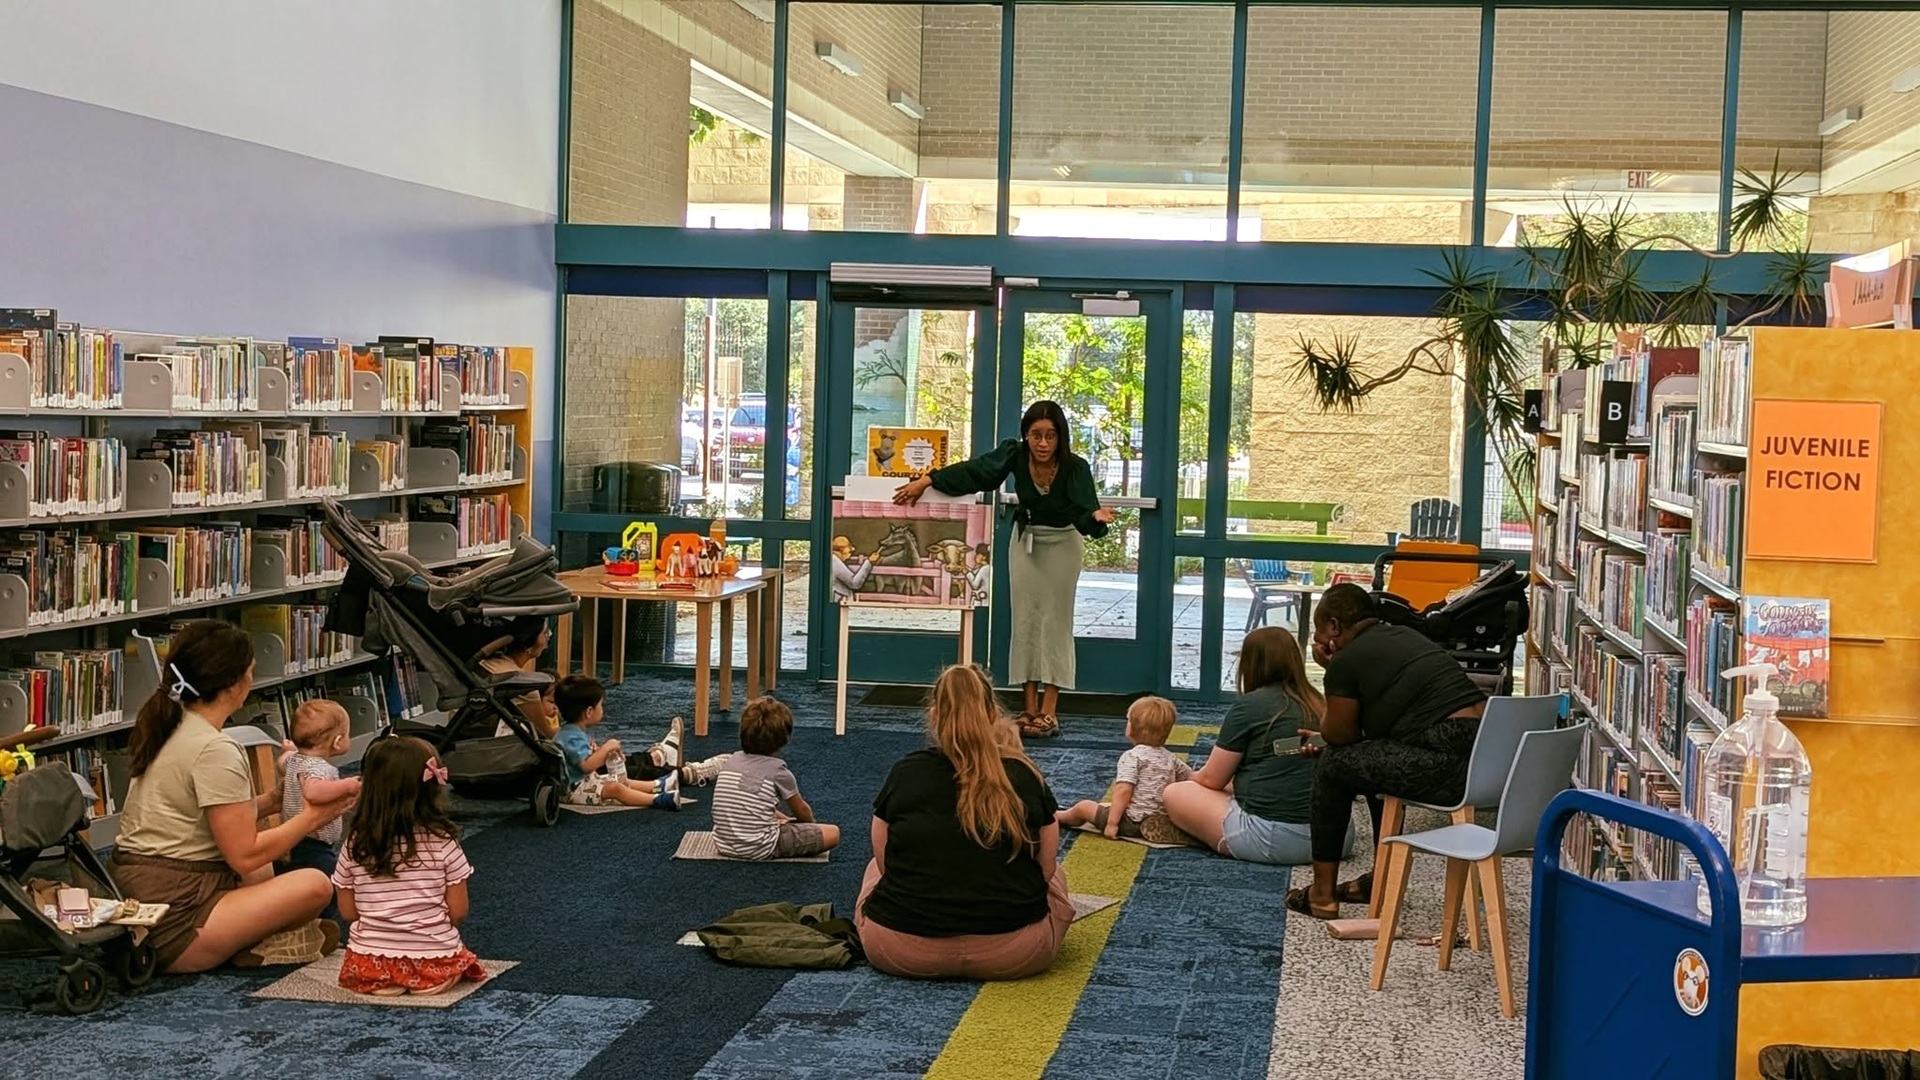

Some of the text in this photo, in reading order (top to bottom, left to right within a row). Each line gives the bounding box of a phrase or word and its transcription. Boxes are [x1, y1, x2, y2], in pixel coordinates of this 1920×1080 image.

[1628, 171, 1652, 188] EXIT
[1527, 404, 1539, 417] A
[1607, 402, 1622, 421] B
[1760, 436, 1870, 458] JUVENILE
[1766, 470, 1861, 491] FICTION
